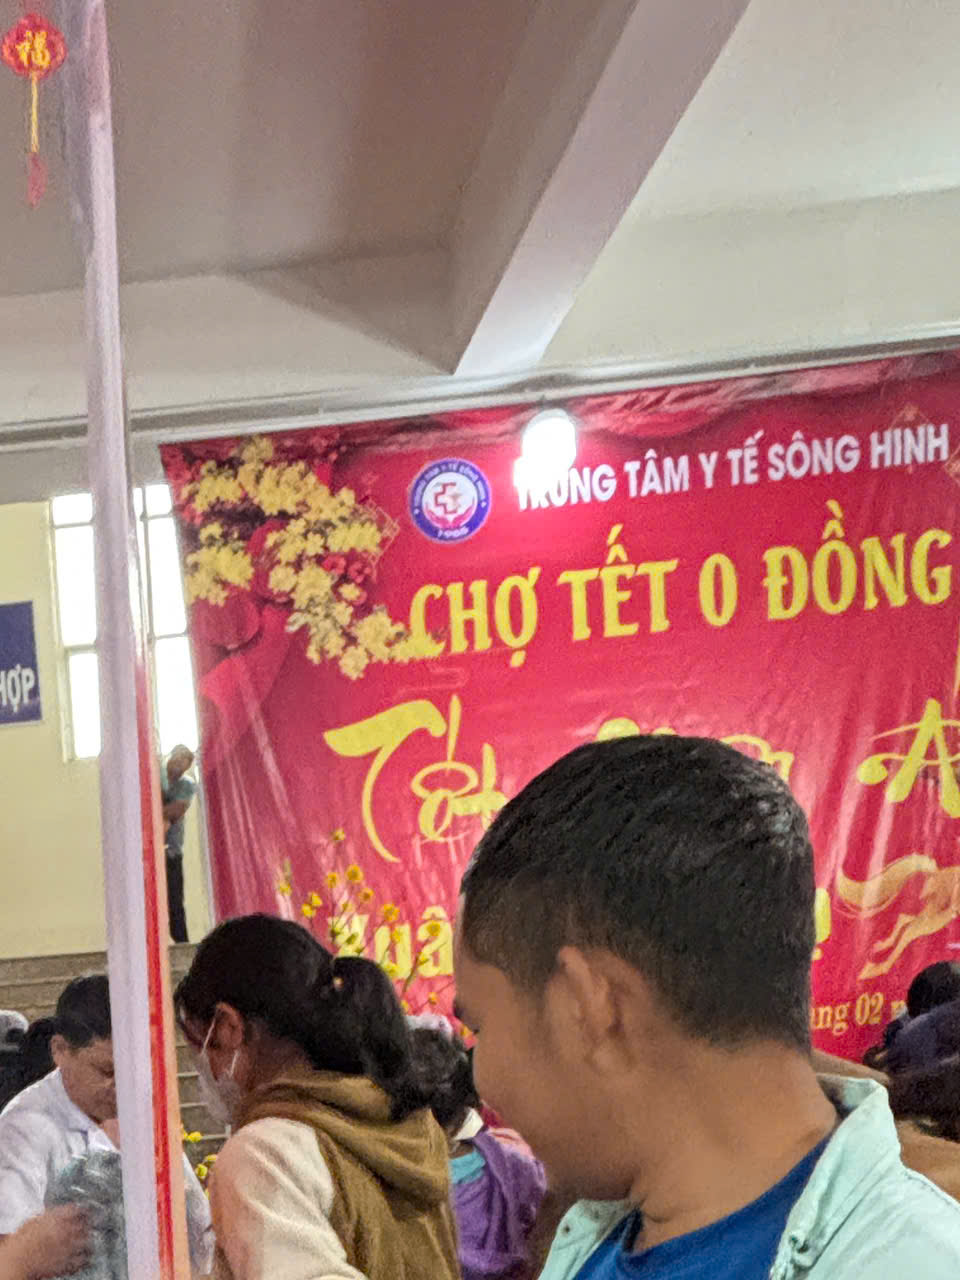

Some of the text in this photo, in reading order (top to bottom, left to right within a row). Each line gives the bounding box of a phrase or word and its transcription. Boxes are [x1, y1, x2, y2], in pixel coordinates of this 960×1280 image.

[624, 448, 690, 497] TÂM
[698, 453, 719, 489] Y
[726, 429, 765, 485] TẾ
[767, 431, 860, 481] SÔNG
[869, 423, 950, 469] HINH
[408, 566, 541, 668] CHỢ
[557, 523, 679, 642] TẾT
[762, 499, 952, 620] ĐỒNG
[328, 905, 454, 979] Xuâ
[855, 992, 884, 1025] 02
